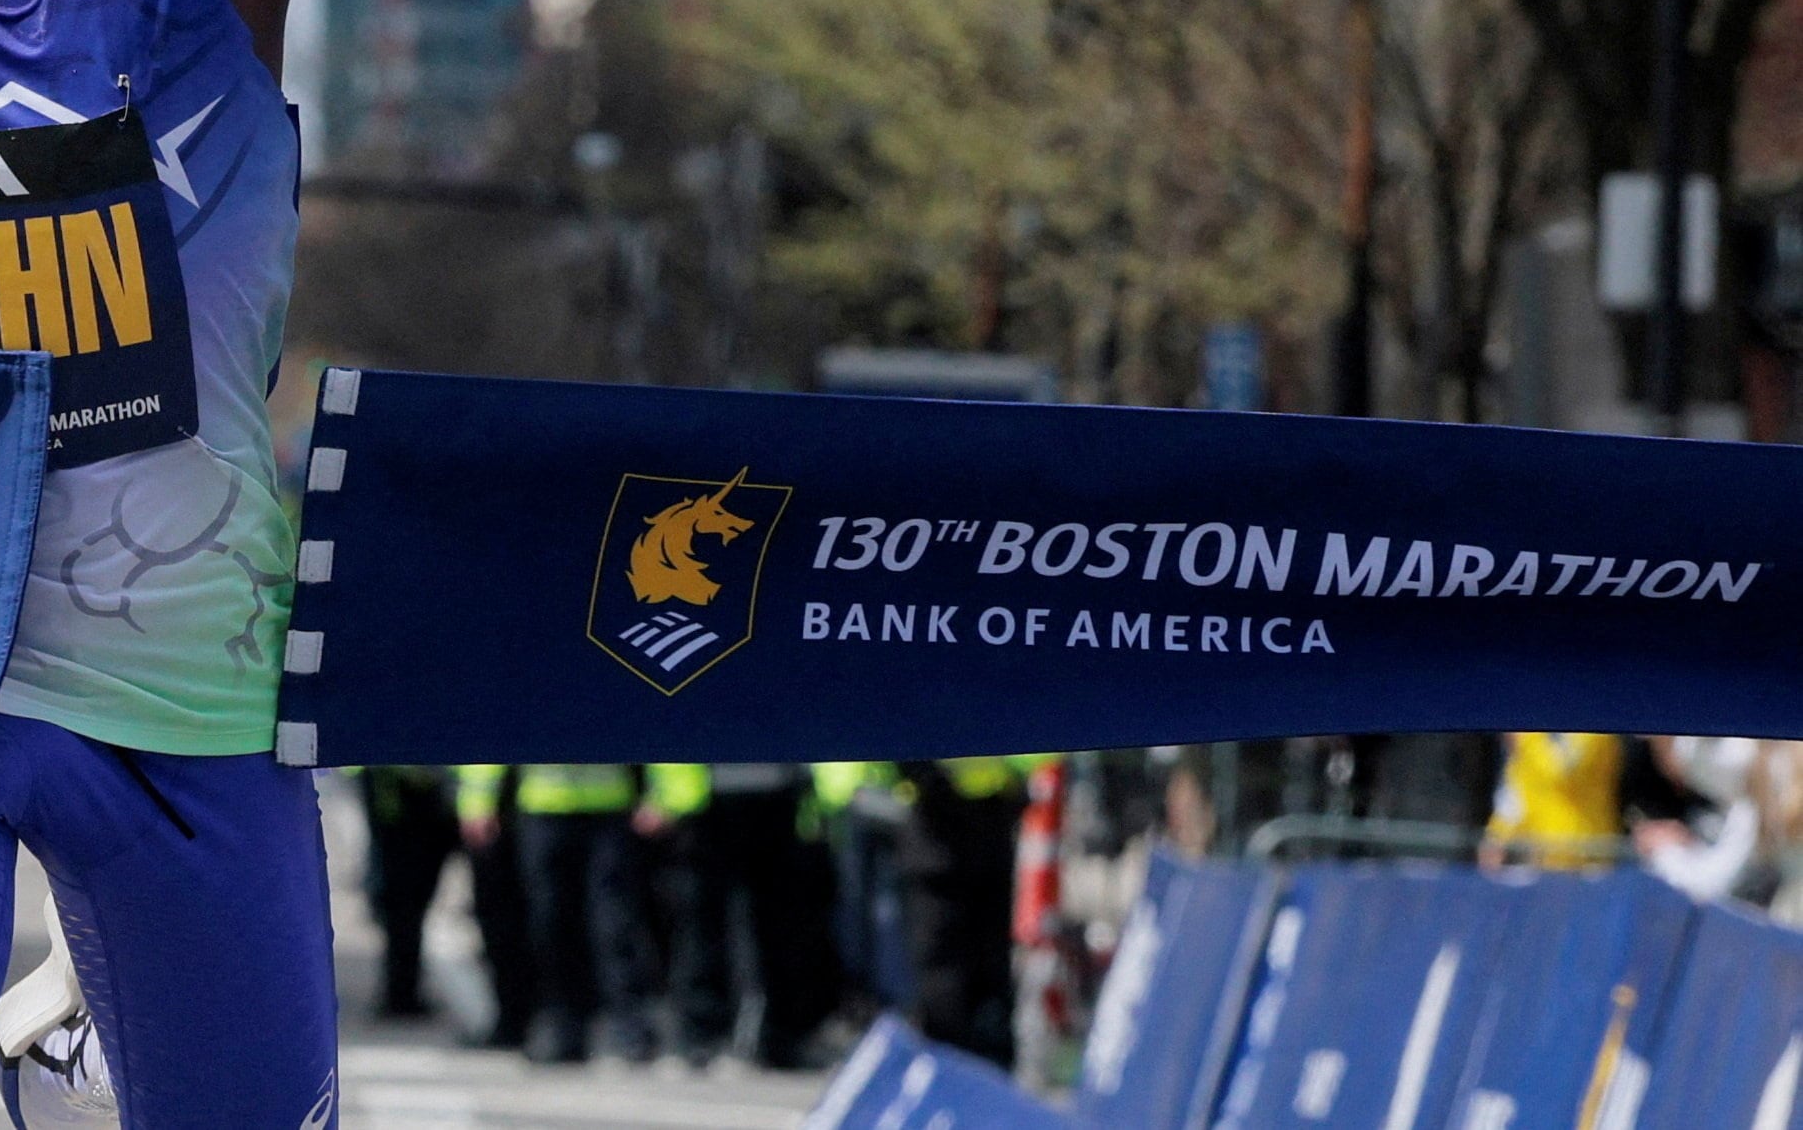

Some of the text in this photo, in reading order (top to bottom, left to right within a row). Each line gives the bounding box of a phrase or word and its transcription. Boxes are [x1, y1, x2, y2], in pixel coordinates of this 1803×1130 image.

[49, 394, 161, 432] MARATHON
[812, 516, 1762, 602] 130TH BOSTON MARATHON
[802, 602, 1336, 654] BANK OF AMERICA
